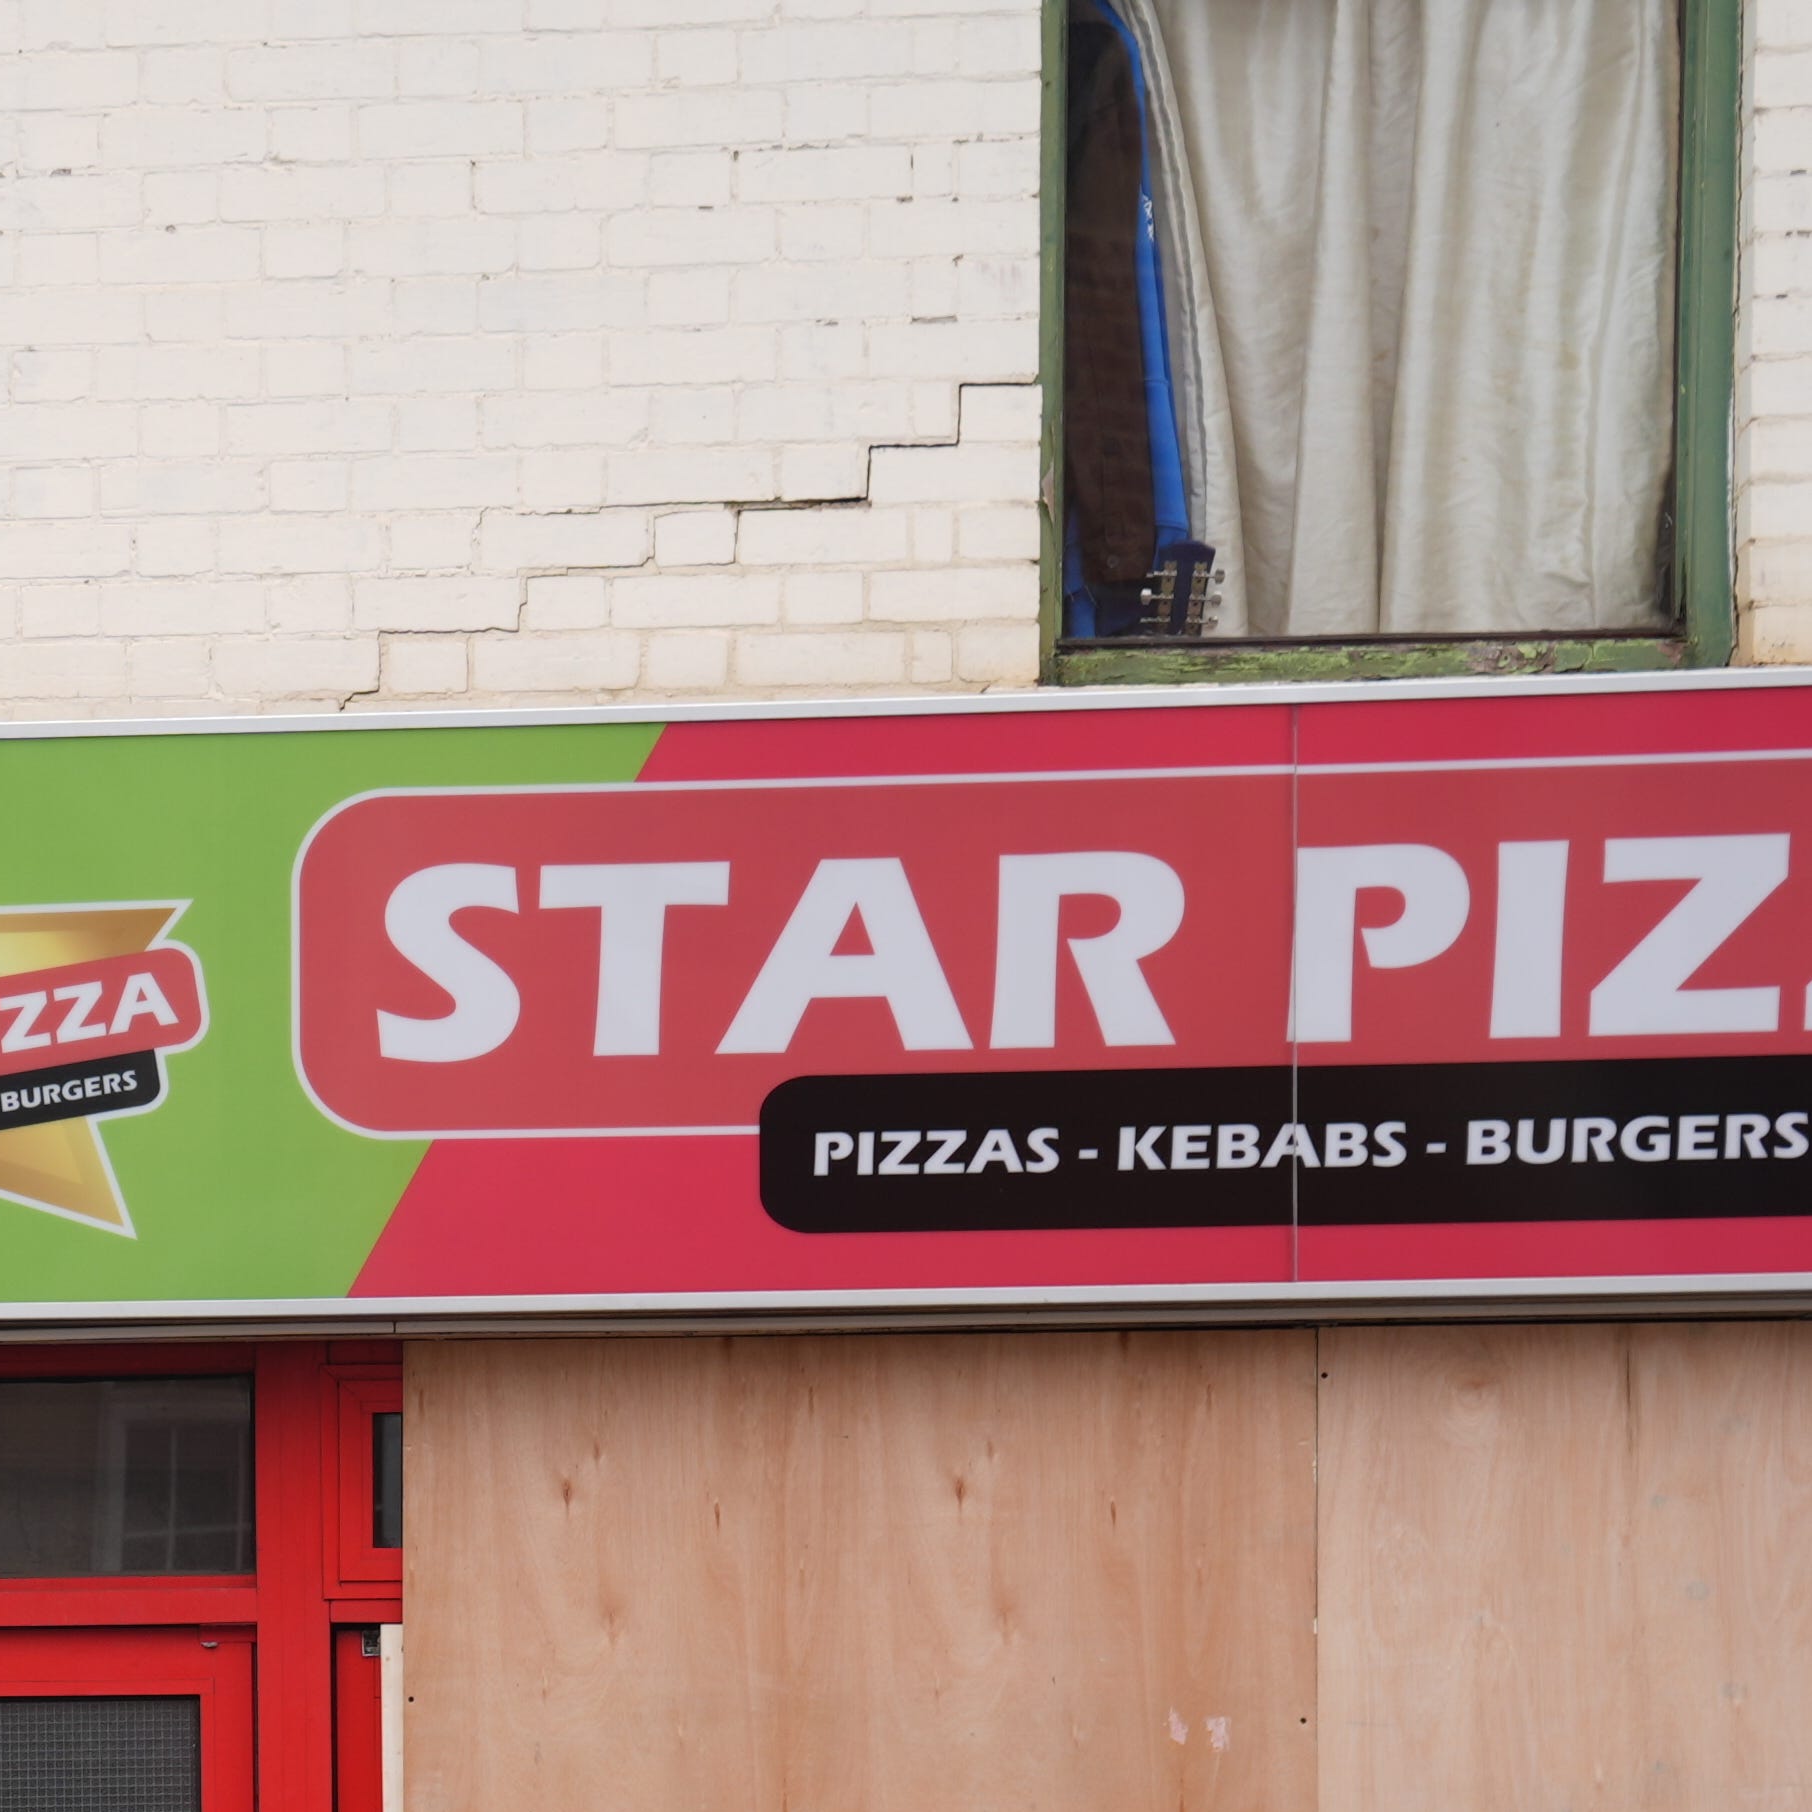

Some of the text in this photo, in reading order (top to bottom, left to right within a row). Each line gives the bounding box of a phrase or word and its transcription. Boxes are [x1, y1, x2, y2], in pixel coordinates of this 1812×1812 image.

[376, 835, 1812, 1063] STAR PIZ
[0, 1070, 137, 1112] BURGERS
[813, 1127, 1060, 1176] PIZZAS
[1117, 1122, 1407, 1171] KEBABS
[1466, 1112, 1809, 1164] BURGERS
